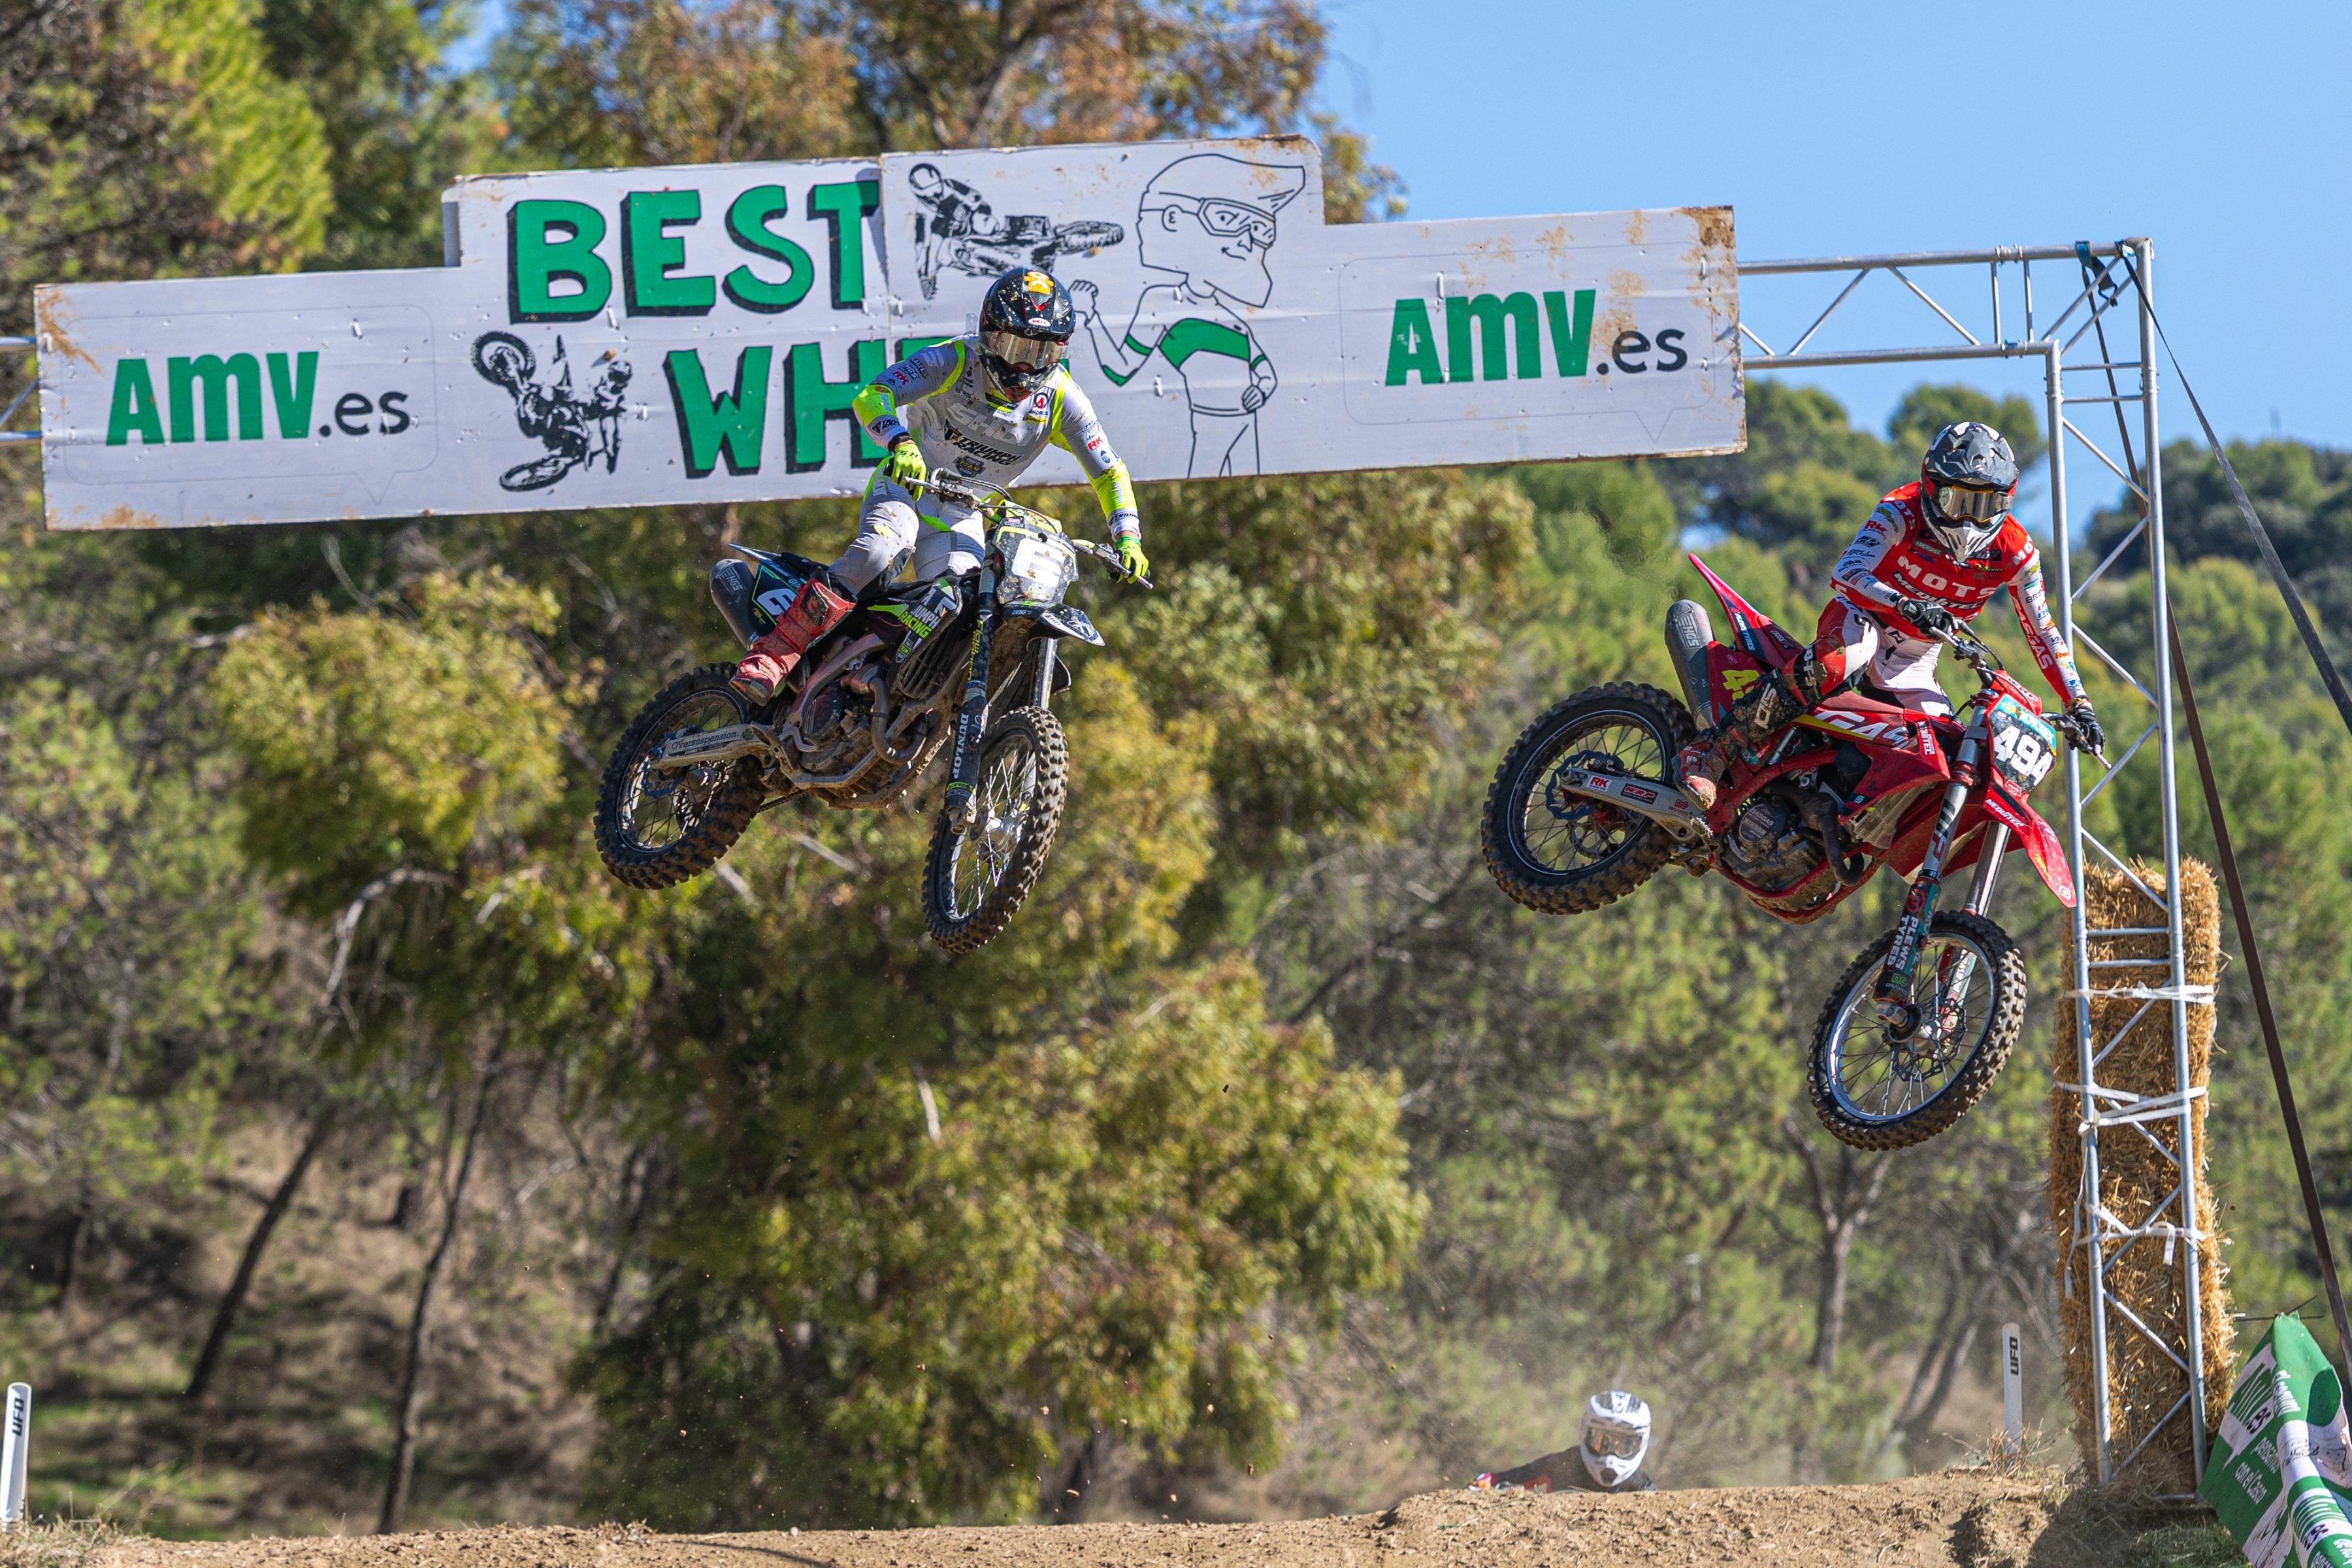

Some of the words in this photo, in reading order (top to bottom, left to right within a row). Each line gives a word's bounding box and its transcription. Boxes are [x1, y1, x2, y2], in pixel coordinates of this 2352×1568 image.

[507, 180, 879, 325] BEST
[892, 370, 909, 385] RK
[953, 441, 1013, 466] RACING
[959, 436, 1024, 462] TRIUMPH
[1088, 436, 1104, 451] RK
[727, 575, 744, 592] HGS
[898, 611, 933, 639] RACING
[1683, 629, 1700, 647] HGS
[953, 713, 969, 779] DUNLOP
[1590, 776, 1610, 788] RK
[1624, 785, 1656, 798] WRP
[1742, 817, 1767, 835] HINSON
[1750, 808, 1774, 826] GASGAS
[1887, 915, 1910, 966] TYRES
[1895, 916, 1919, 970] PLEWS
[2009, 1336, 2019, 1377] UFO
[12, 1397, 25, 1437] UFO
[2234, 1461, 2251, 1486] con
[2247, 1473, 2268, 1505] Casco
